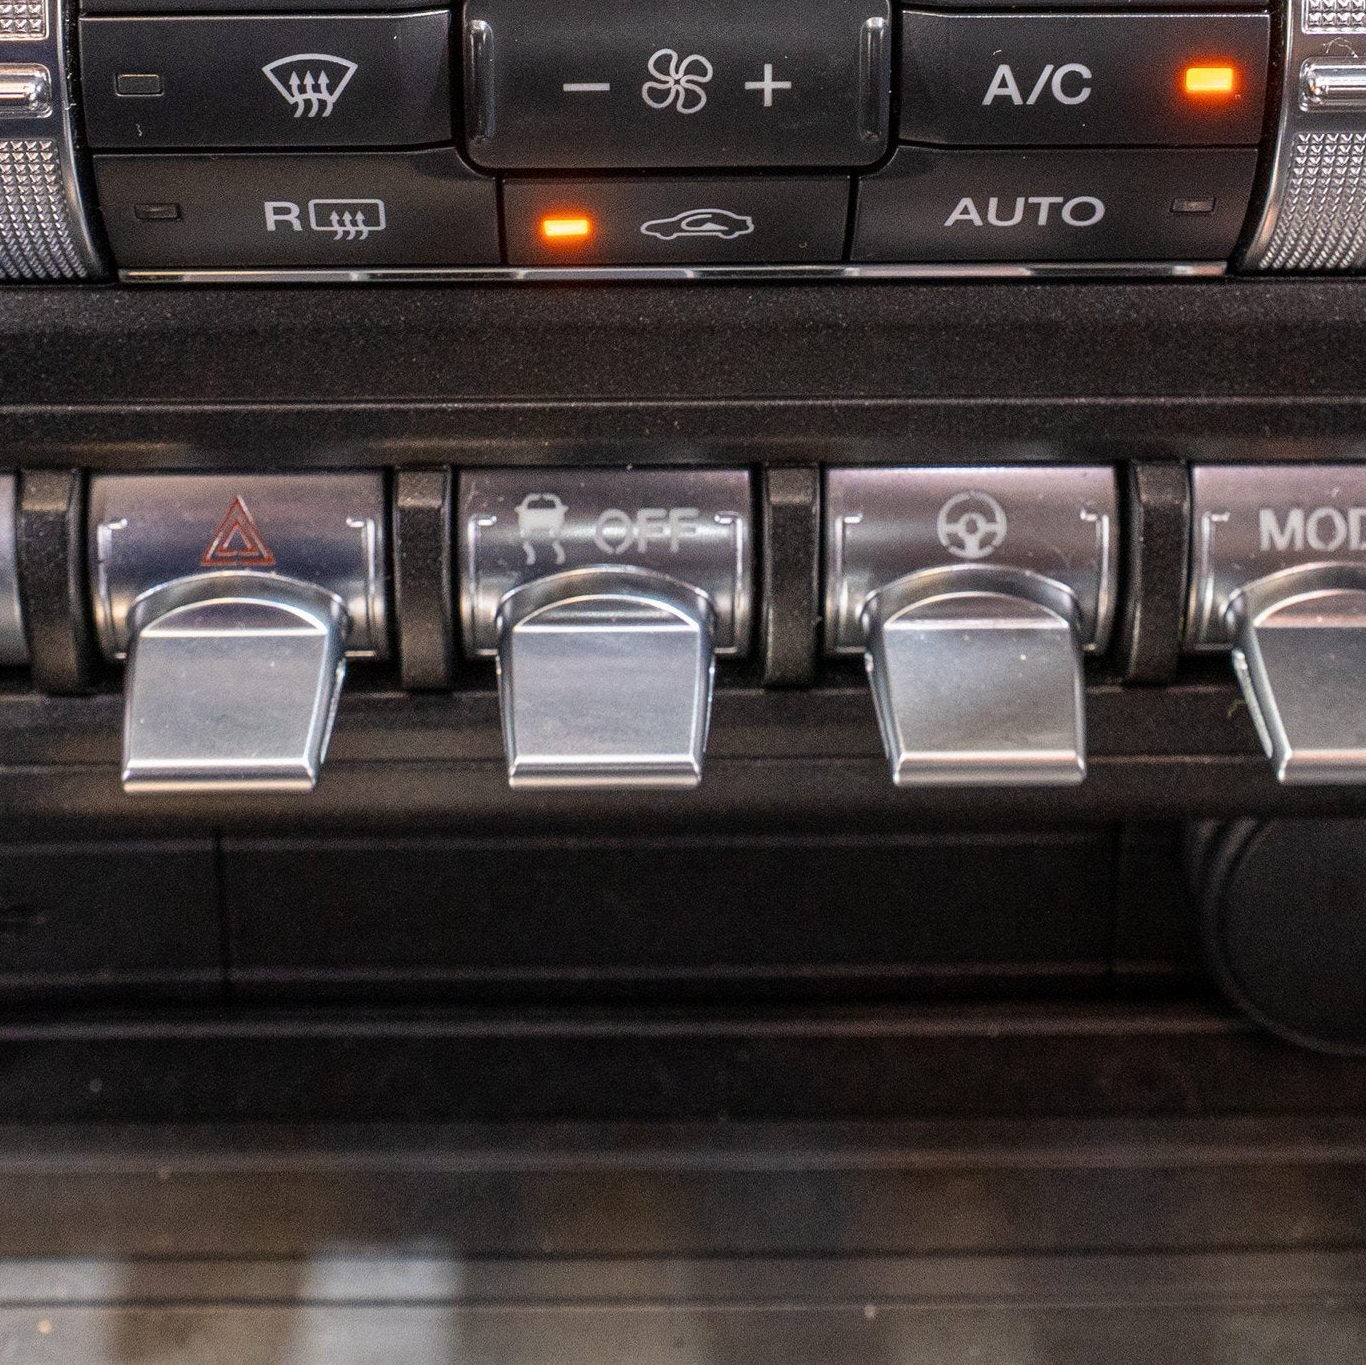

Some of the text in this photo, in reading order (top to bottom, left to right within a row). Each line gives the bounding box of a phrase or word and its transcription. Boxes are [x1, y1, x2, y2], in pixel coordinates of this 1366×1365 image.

[982, 62, 1093, 106] A/C
[264, 201, 303, 232] R
[943, 195, 1106, 228] AUTO
[596, 507, 700, 555] OFF
